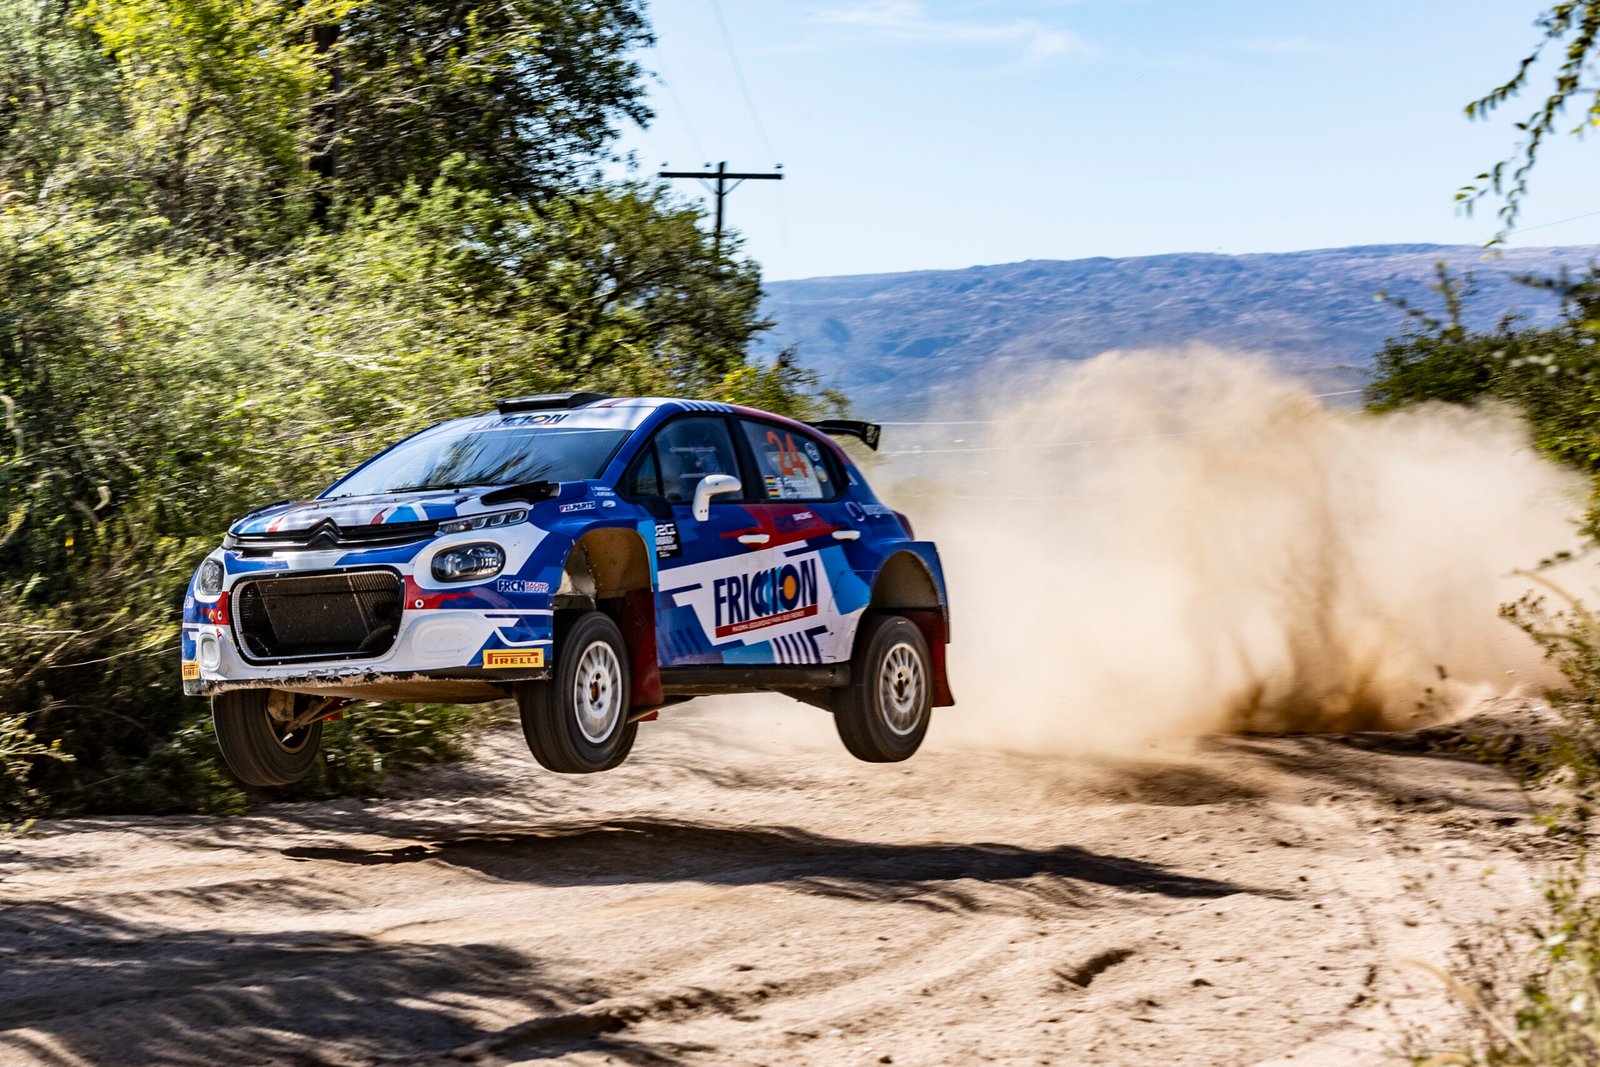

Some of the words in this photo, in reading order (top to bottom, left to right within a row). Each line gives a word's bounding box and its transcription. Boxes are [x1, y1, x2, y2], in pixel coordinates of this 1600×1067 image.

[766, 431, 809, 478] 24
[498, 579, 525, 593] FRCN
[714, 559, 817, 627] FRICCION
[487, 652, 540, 665] PIRELLI
